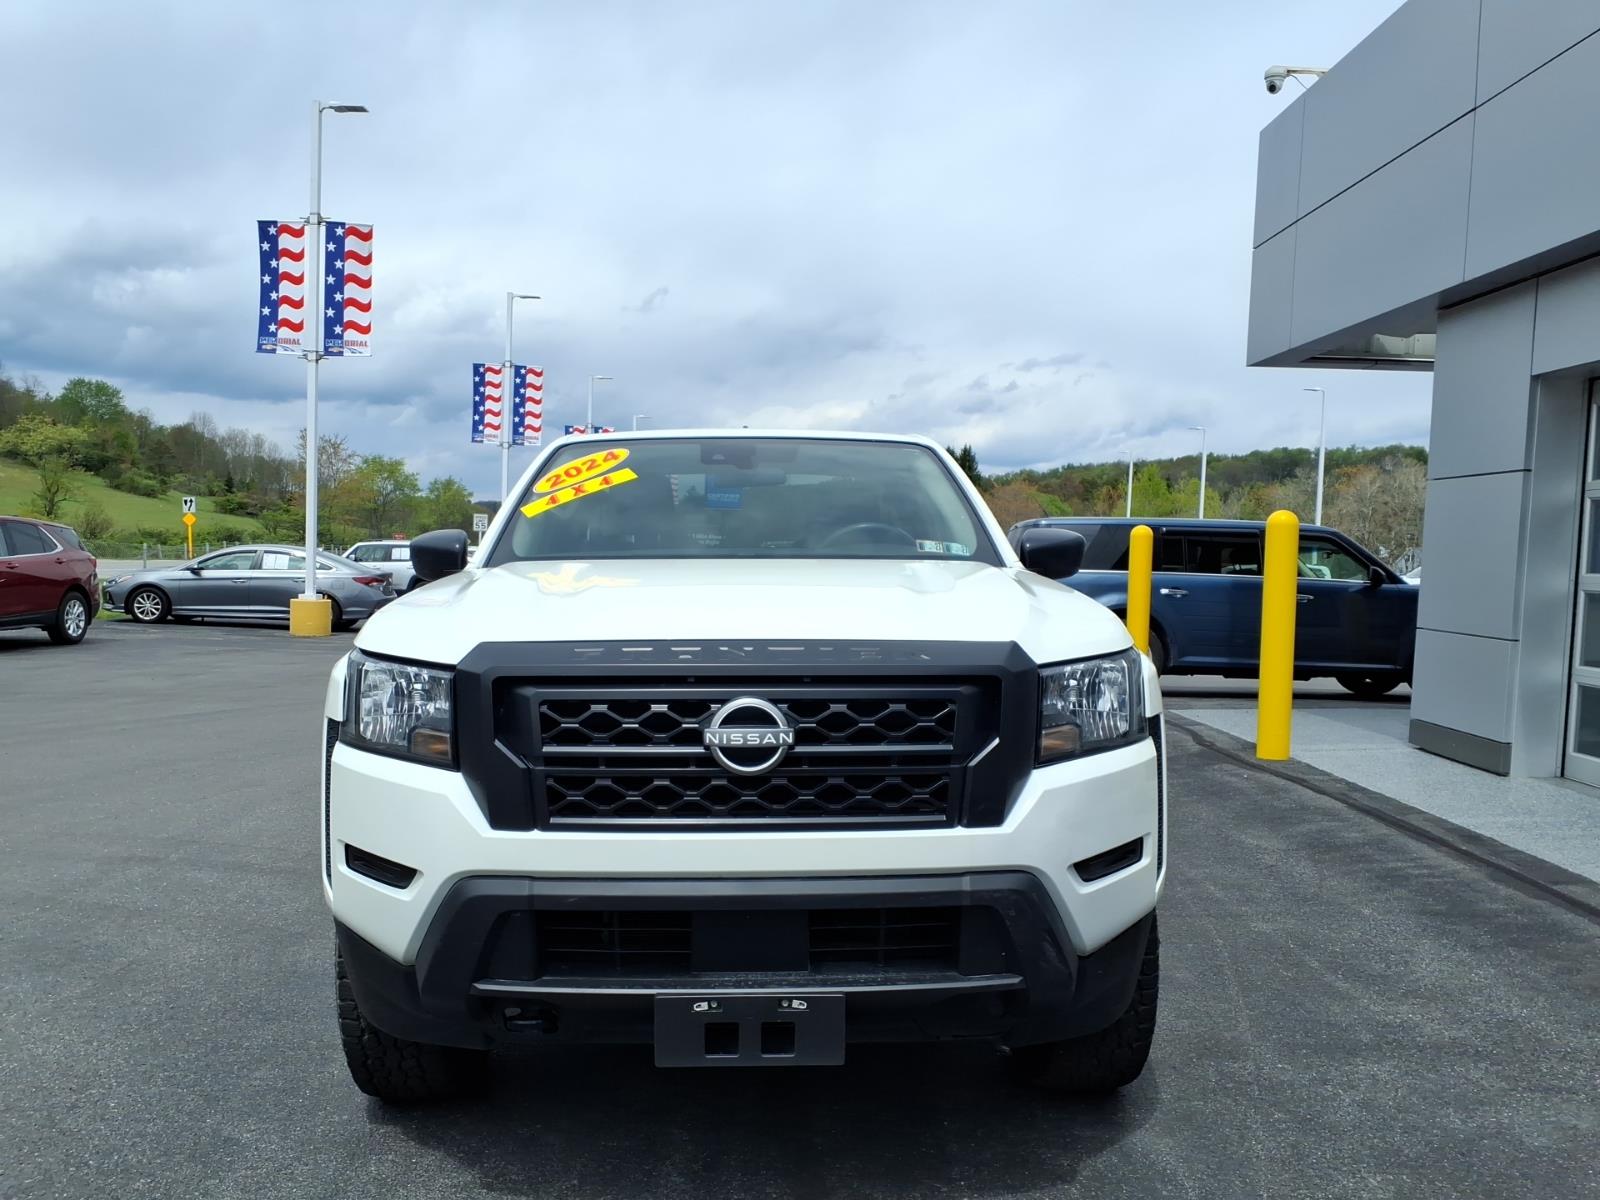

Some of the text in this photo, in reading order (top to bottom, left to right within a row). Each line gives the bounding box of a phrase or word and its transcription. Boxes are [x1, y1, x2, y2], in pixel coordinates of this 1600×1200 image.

[545, 451, 621, 489] 2024
[545, 494, 560, 506] 4
[598, 475, 613, 486] 4
[475, 521, 487, 530] 55
[706, 732, 793, 745] NISSAN
